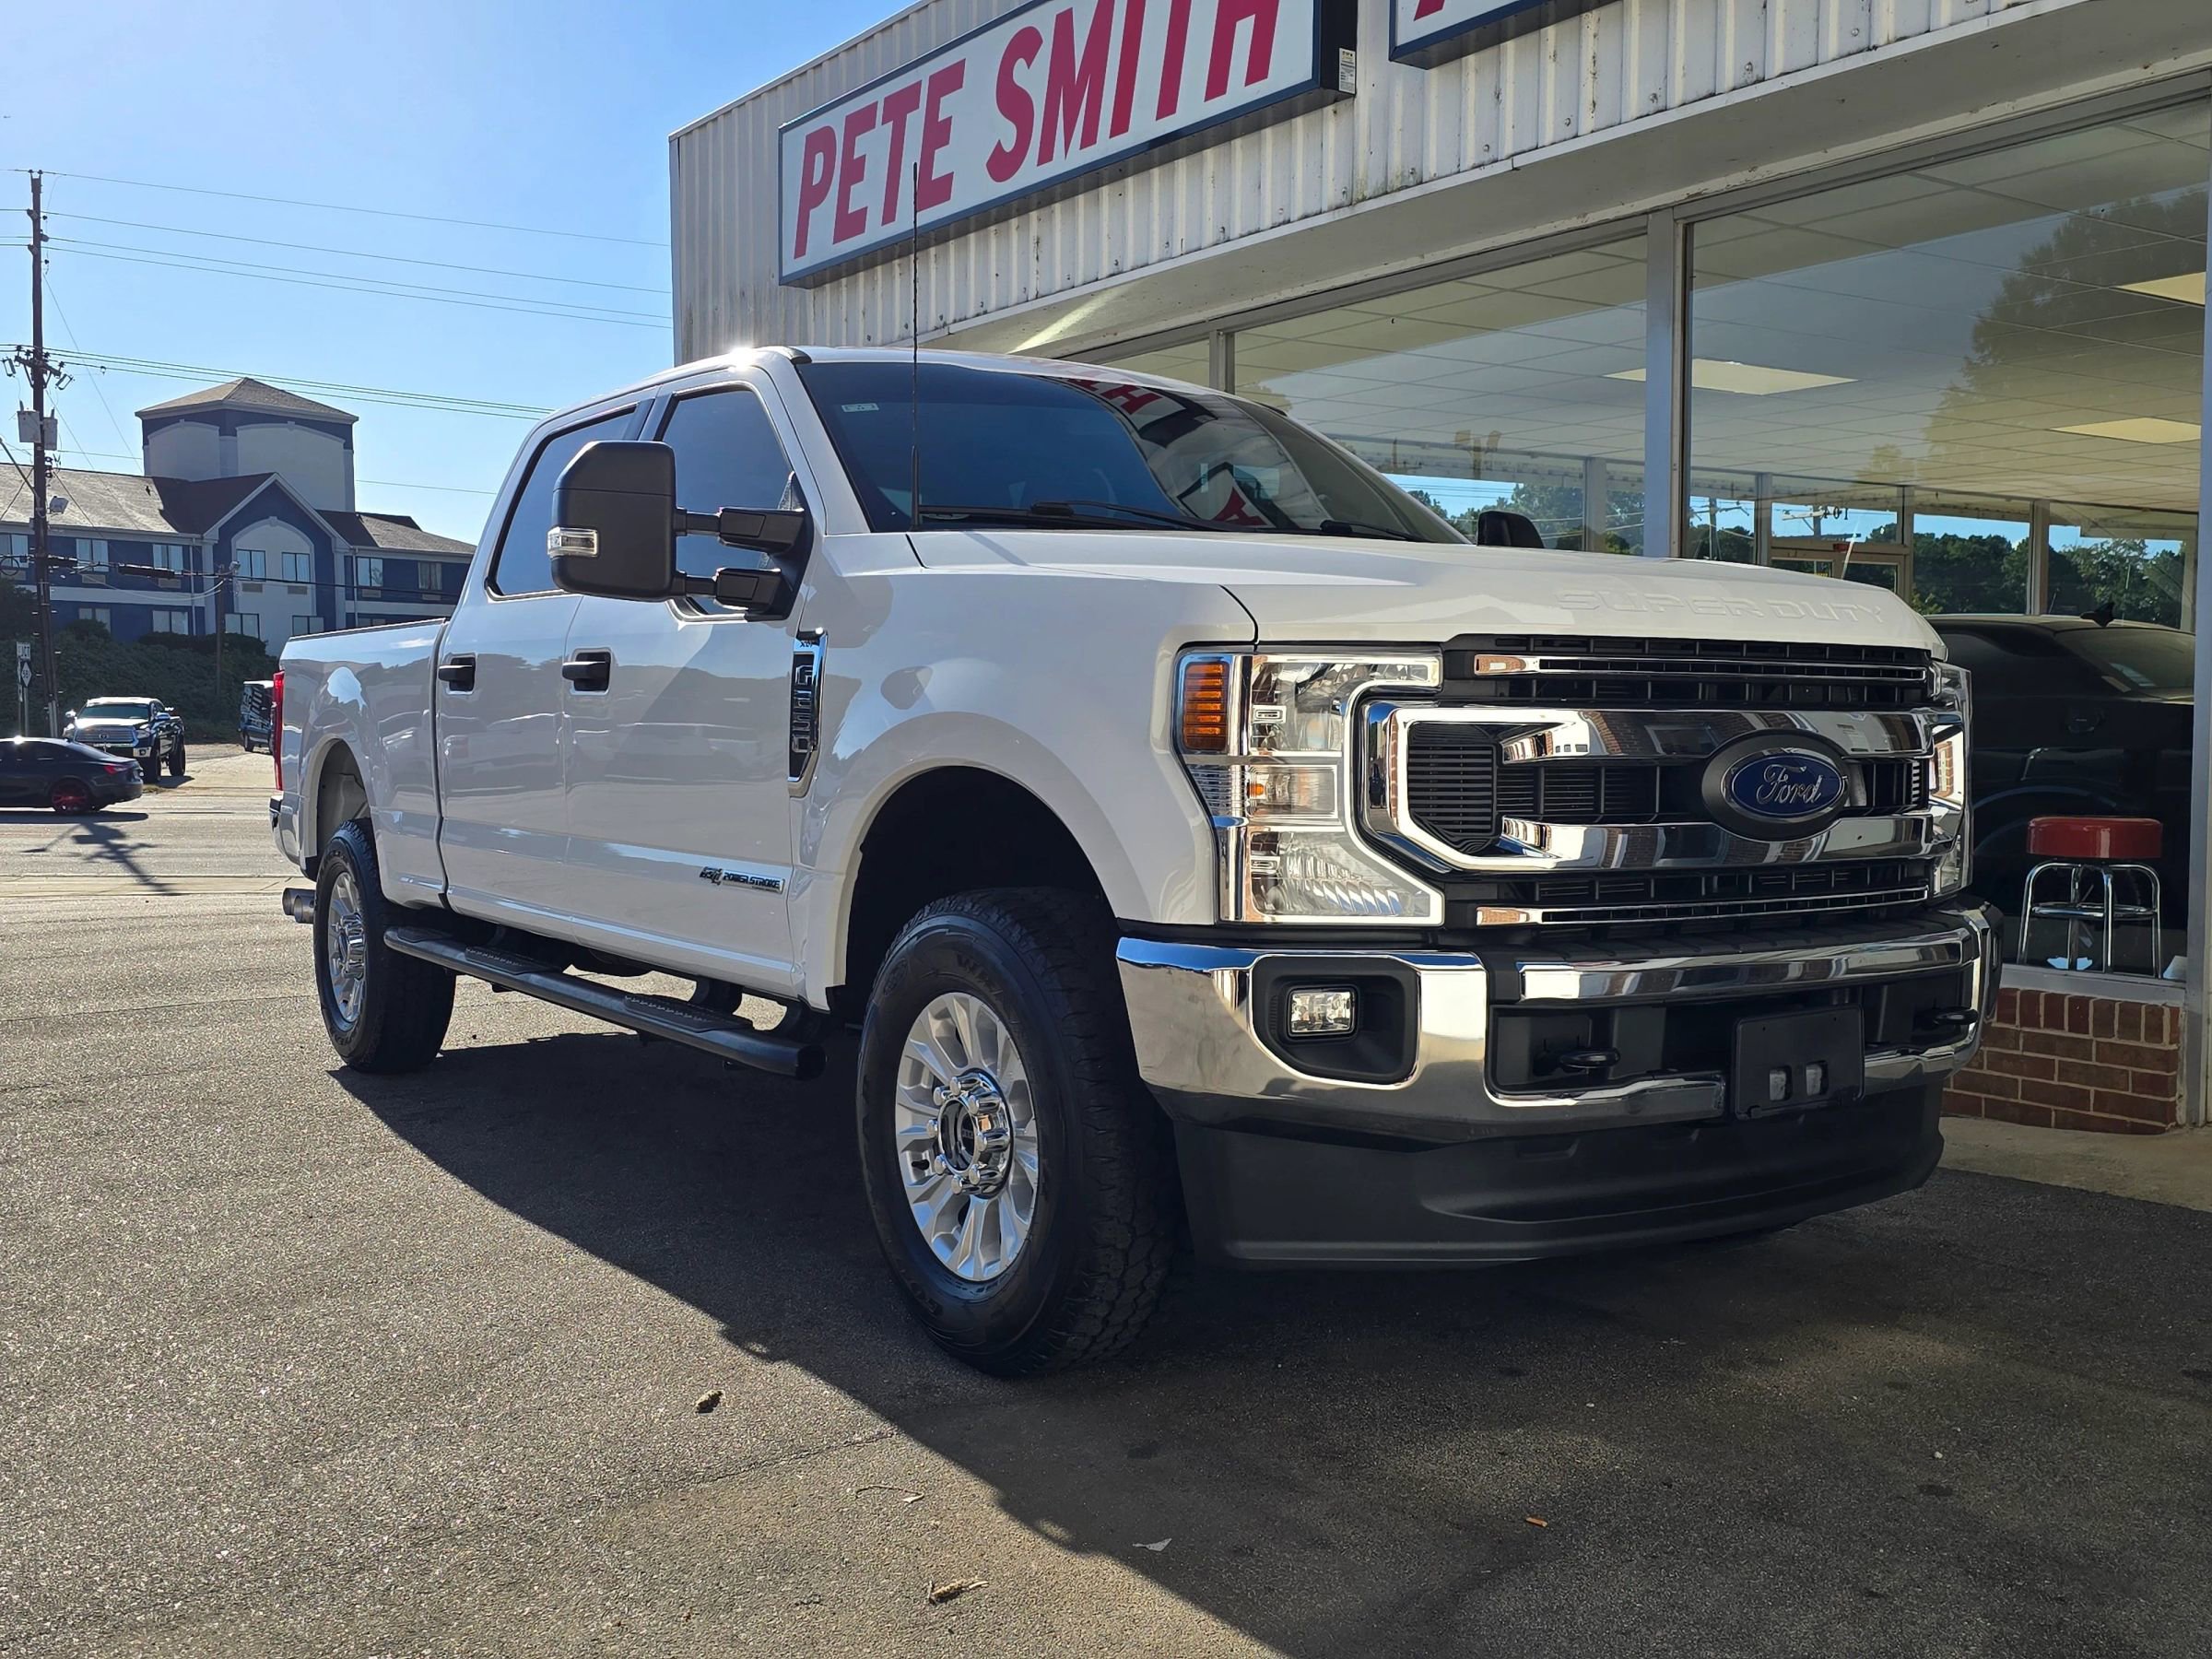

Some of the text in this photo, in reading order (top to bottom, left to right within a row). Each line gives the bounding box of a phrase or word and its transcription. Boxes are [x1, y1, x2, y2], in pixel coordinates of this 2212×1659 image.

[794, 58, 965, 259] PETE
[1558, 590, 1883, 624] SUPER DUTY
[1756, 763, 1823, 804] Ford
